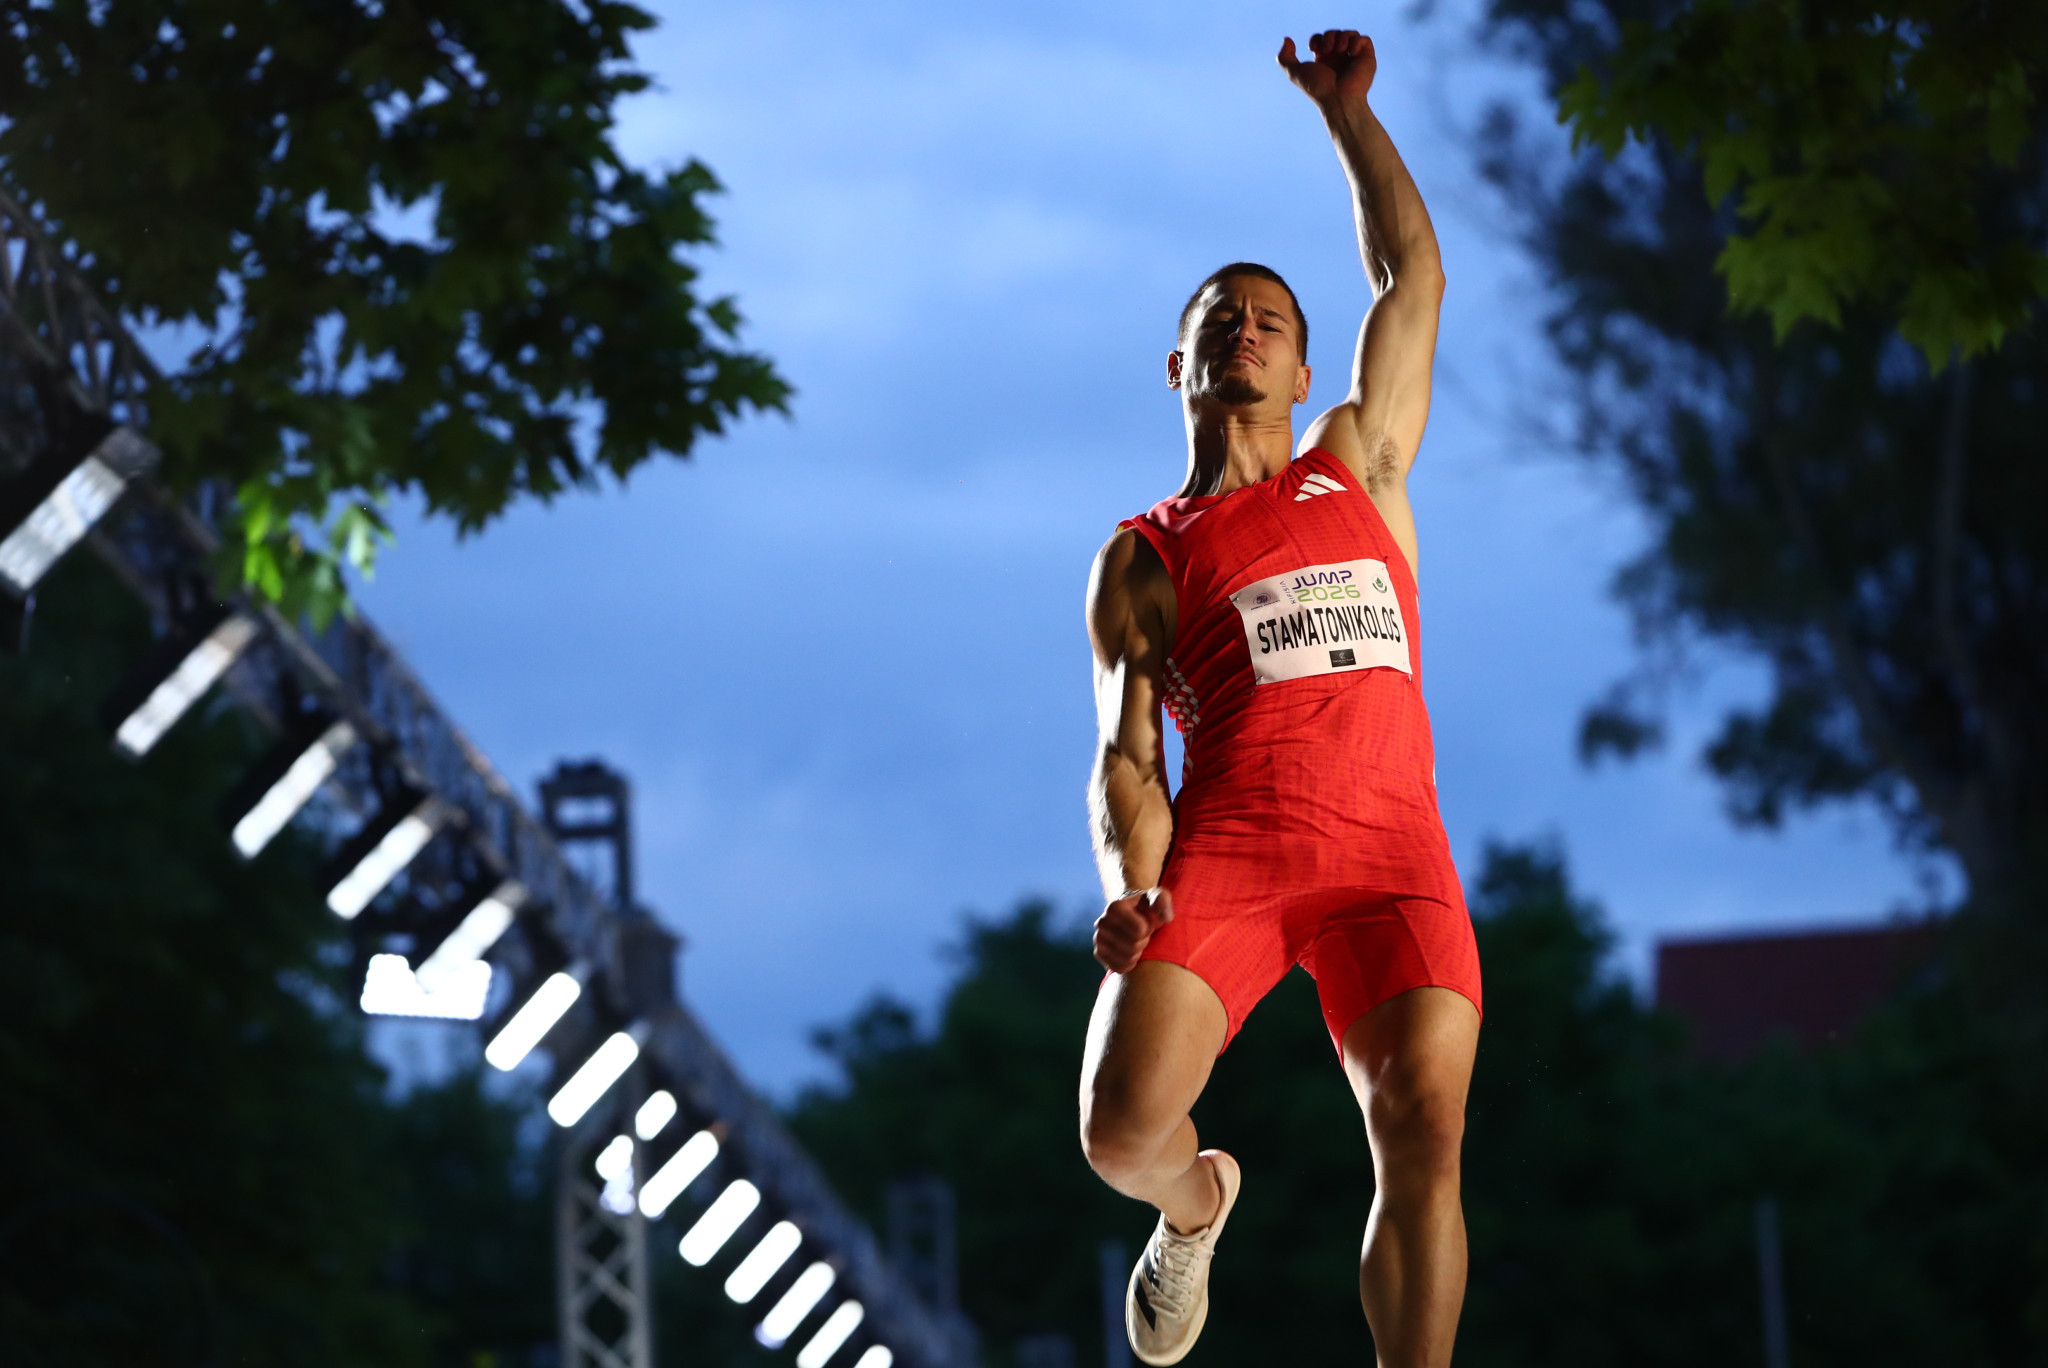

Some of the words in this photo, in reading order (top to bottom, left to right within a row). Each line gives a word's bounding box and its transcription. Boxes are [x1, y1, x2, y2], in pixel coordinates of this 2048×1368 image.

[1292, 570, 1353, 590] JUMP
[1294, 584, 1361, 603] 2026
[1257, 605, 1401, 654] STAMATONIKOLOS
